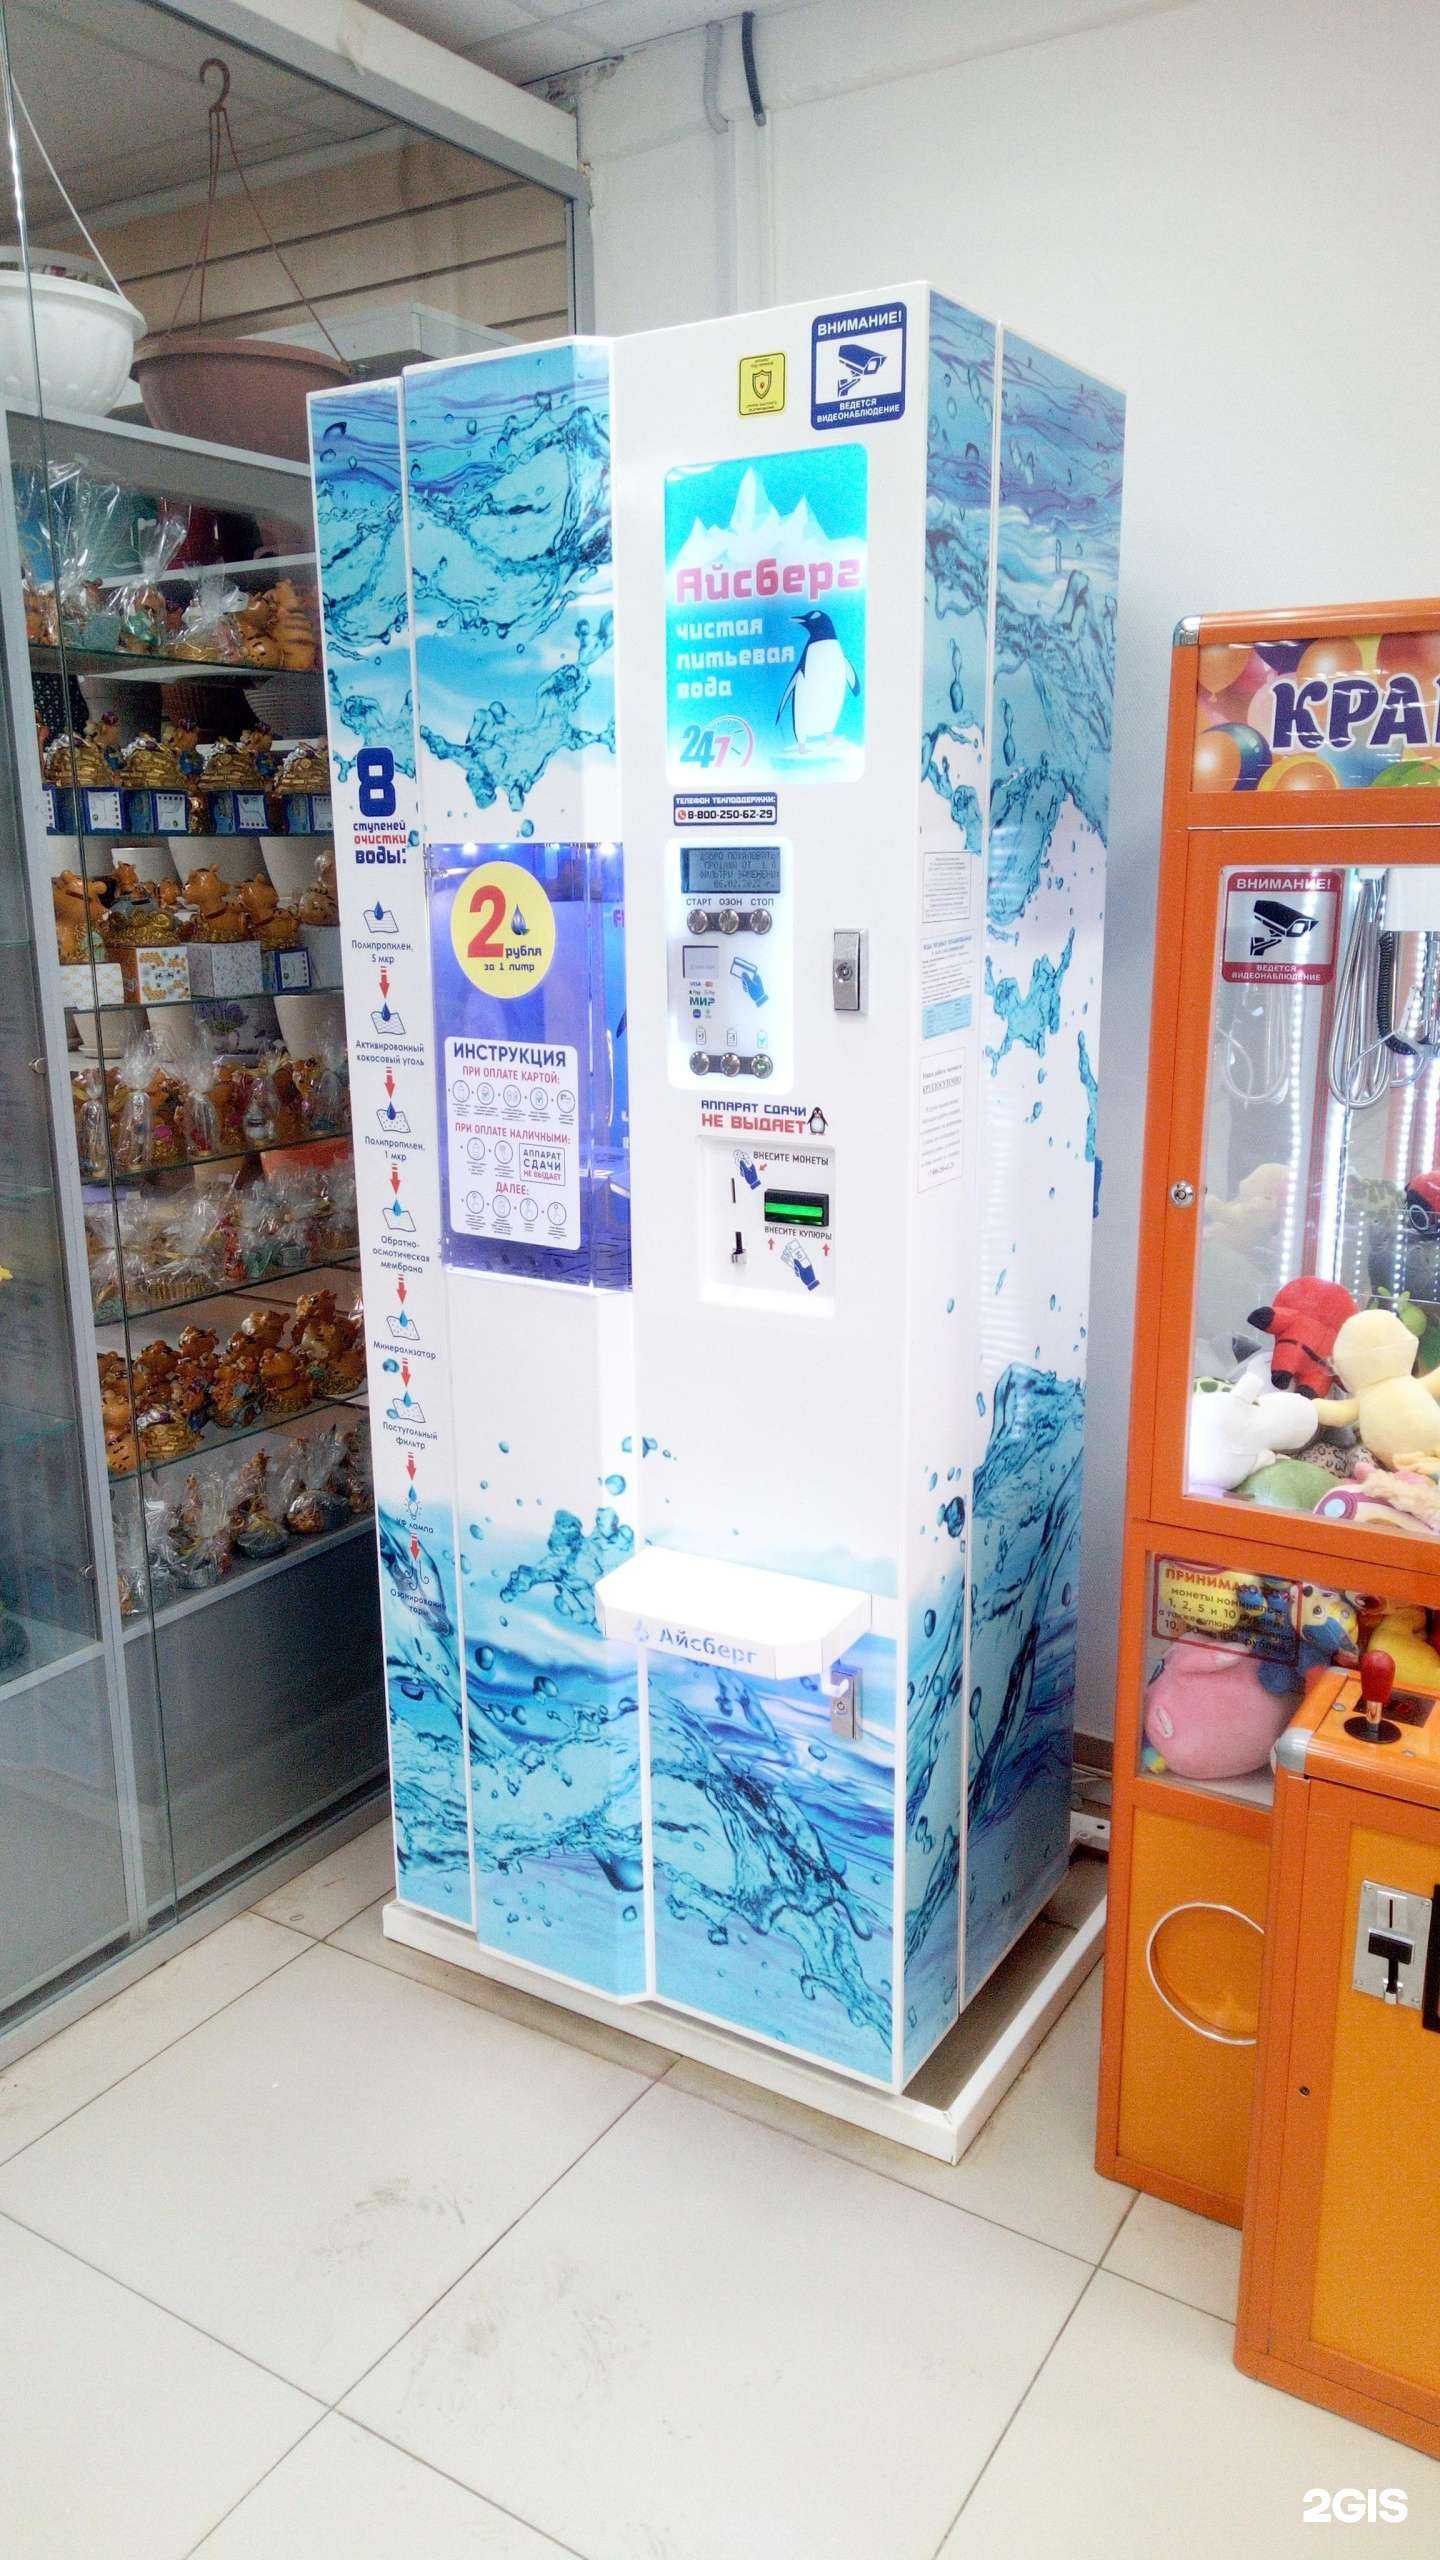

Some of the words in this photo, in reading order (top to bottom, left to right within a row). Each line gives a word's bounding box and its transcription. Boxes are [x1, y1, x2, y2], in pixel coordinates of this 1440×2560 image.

[817, 310, 902, 336] ВНИМАНИЕ!
[839, 398, 877, 411] ВЕДЕТСЯ
[817, 404, 900, 423] ВИДЕОНАБЛЮДЕНИЕ
[676, 558, 860, 603] Айсберг
[676, 617, 763, 640] чистая
[676, 645, 794, 670] питьевая
[676, 676, 732, 699] вода
[1271, 674, 1440, 750] КРА
[357, 747, 396, 817] 8
[676, 797, 710, 805] ТЕЛЕФОН
[688, 809, 773, 819] 8-800-250-62-29
[353, 819, 406, 832] ступеней
[354, 832, 406, 845] очистки
[356, 846, 406, 864] воды:
[1237, 878, 1331, 890] ВНИМАНИЕ!
[686, 898, 711, 906] СТАРТ
[719, 898, 742, 906] ОЗОН
[750, 898, 774, 906] СТОП
[467, 885, 506, 958] 2
[352, 940, 413, 952] Полипропилен,
[505, 945, 542, 959] рубля
[378, 955, 394, 965] мкр
[499, 963, 504, 971] 1
[509, 963, 534, 973] литр
[1256, 964, 1297, 972] ВЕДЕТСЯ
[1232, 971, 1320, 981] ВИДЕОНАБЛЮДЕНИЕ
[689, 996, 715, 1006] МИР
[355, 1039, 424, 1053] Активированный
[356, 1054, 401, 1065] кокосовый
[403, 1056, 424, 1066] уголь
[454, 1042, 566, 1068] ИНСТРУКЦИЯ
[462, 1065, 481, 1076] ПРИ
[483, 1067, 518, 1081] ОПЛАТЕ
[521, 1070, 560, 1084] КАРТОЙ:
[701, 1100, 758, 1113] АППАРАТ
[764, 1104, 807, 1117] СДАЧИ
[701, 1113, 724, 1128] НЕ
[731, 1115, 806, 1134] ВЫДАЕТ
[455, 1122, 473, 1134] ПРИ
[474, 1124, 507, 1137] ОПЛАТЕ
[510, 1128, 571, 1144] НАЛИЧНЫМИ:
[364, 1136, 425, 1151] Полипропилен,
[390, 1152, 407, 1162] мкр
[523, 1148, 561, 1160] АППАРАТ
[753, 1151, 790, 1162] ВНЕСИТЕ
[792, 1154, 829, 1166] МОНЕТЫ
[523, 1160, 561, 1171] СДАЧИ
[523, 1170, 533, 1178] НЕ
[533, 1171, 561, 1182] ВЫДАЕТ
[496, 1181, 529, 1195] ДАЛЕЕ:
[764, 1226, 797, 1237] ВНЕСИТЕ
[799, 1229, 832, 1240] КУПЮРЫ
[380, 1235, 420, 1249] Обратно-
[372, 1248, 430, 1263] осмотическая
[380, 1261, 423, 1274] мембрана
[373, 1340, 437, 1360] Минерализатор
[382, 1420, 438, 1440] Постугольный
[396, 1436, 426, 1450] фильтр
[409, 1522, 434, 1534] лампа
[1171, 1587, 1214, 1603] монеты
[1197, 1603, 1204, 1613] 5
[1224, 1609, 1237, 1619] 10
[659, 1627, 758, 1664] Айсберг
